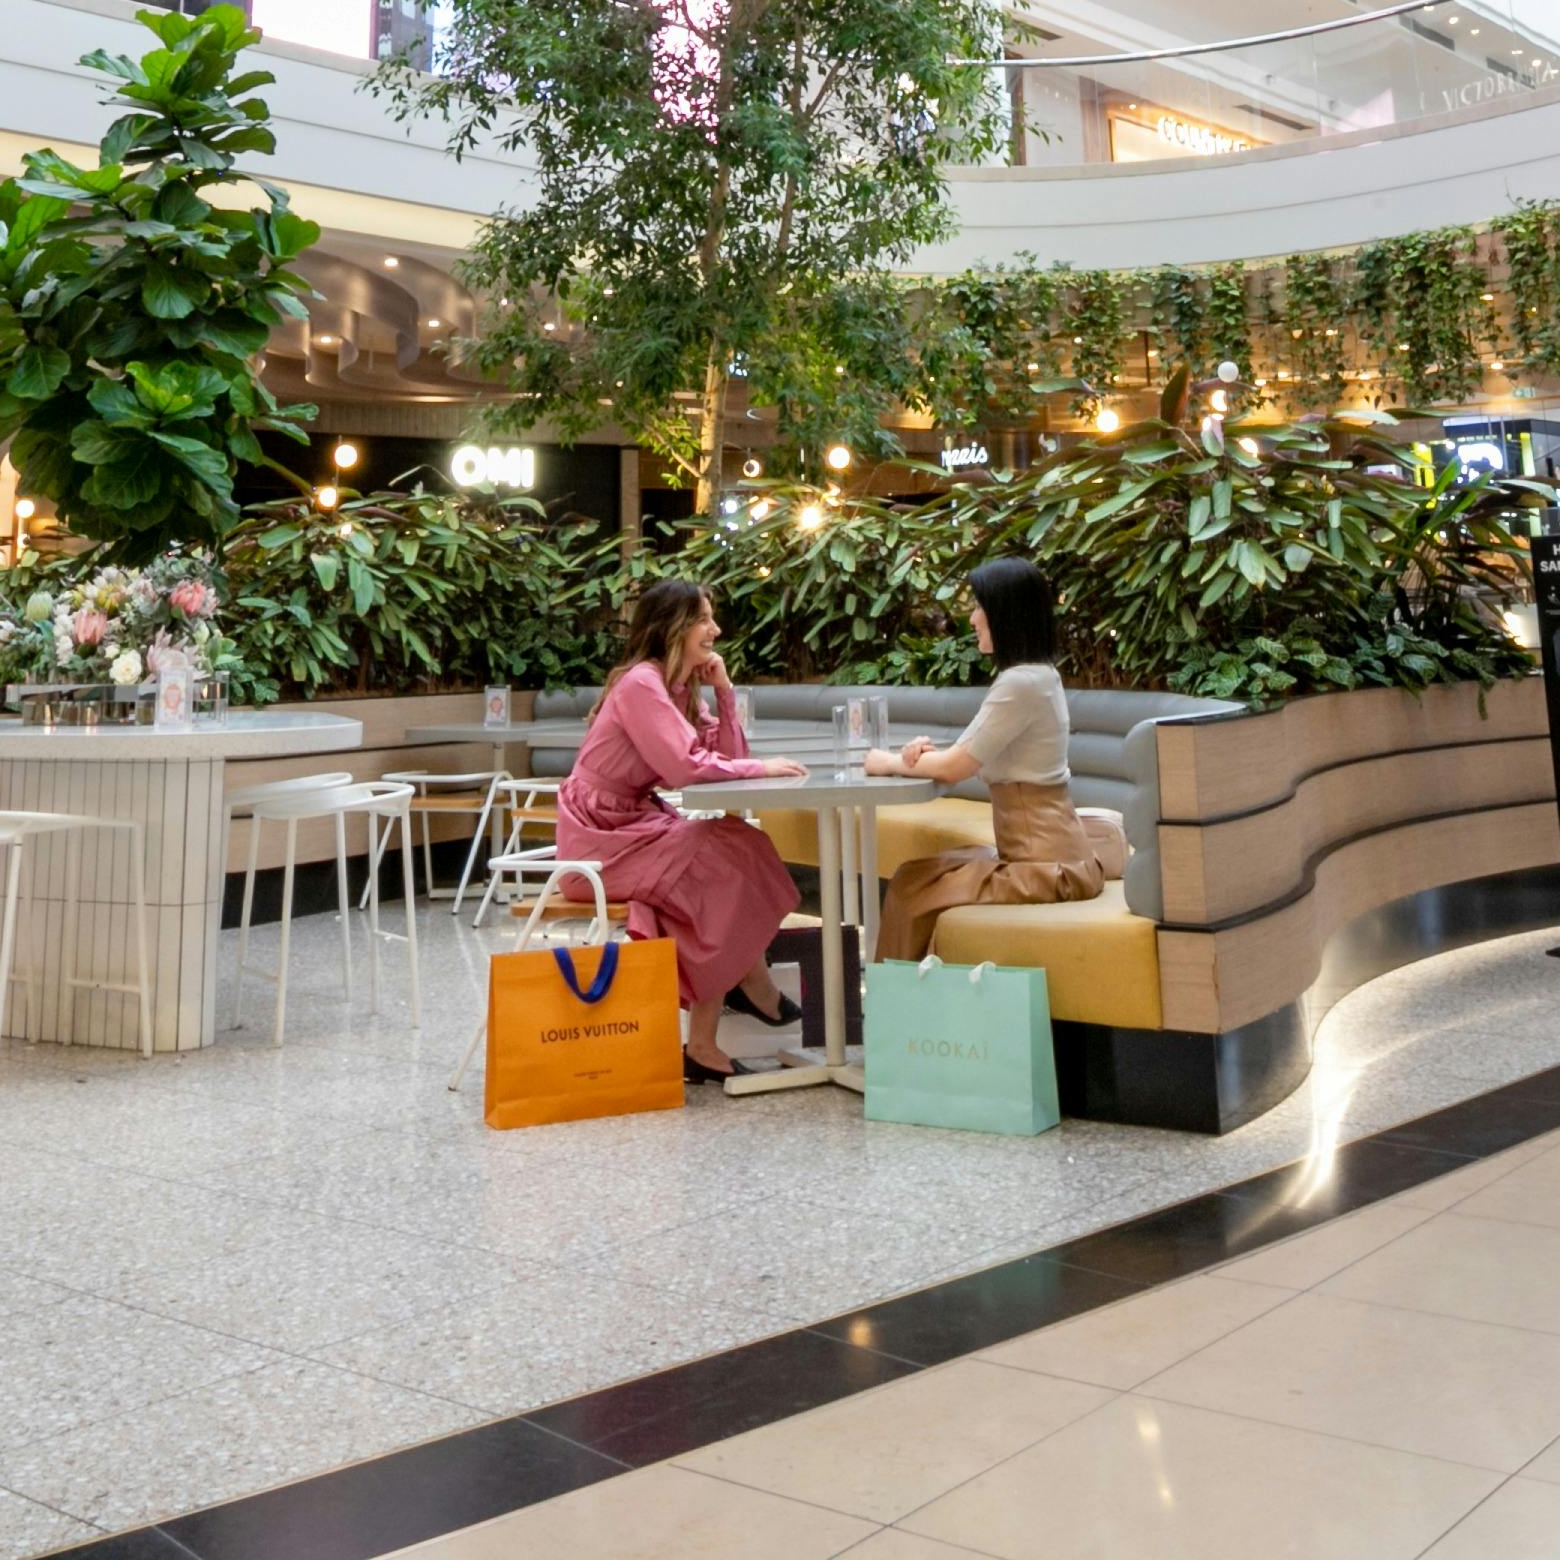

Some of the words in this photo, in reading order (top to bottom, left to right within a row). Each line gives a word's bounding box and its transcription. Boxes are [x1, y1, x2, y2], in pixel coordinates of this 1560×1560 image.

[451, 445, 534, 489] OMI
[541, 1027, 580, 1044] LOUIS
[583, 1020, 639, 1038] VUITTON
